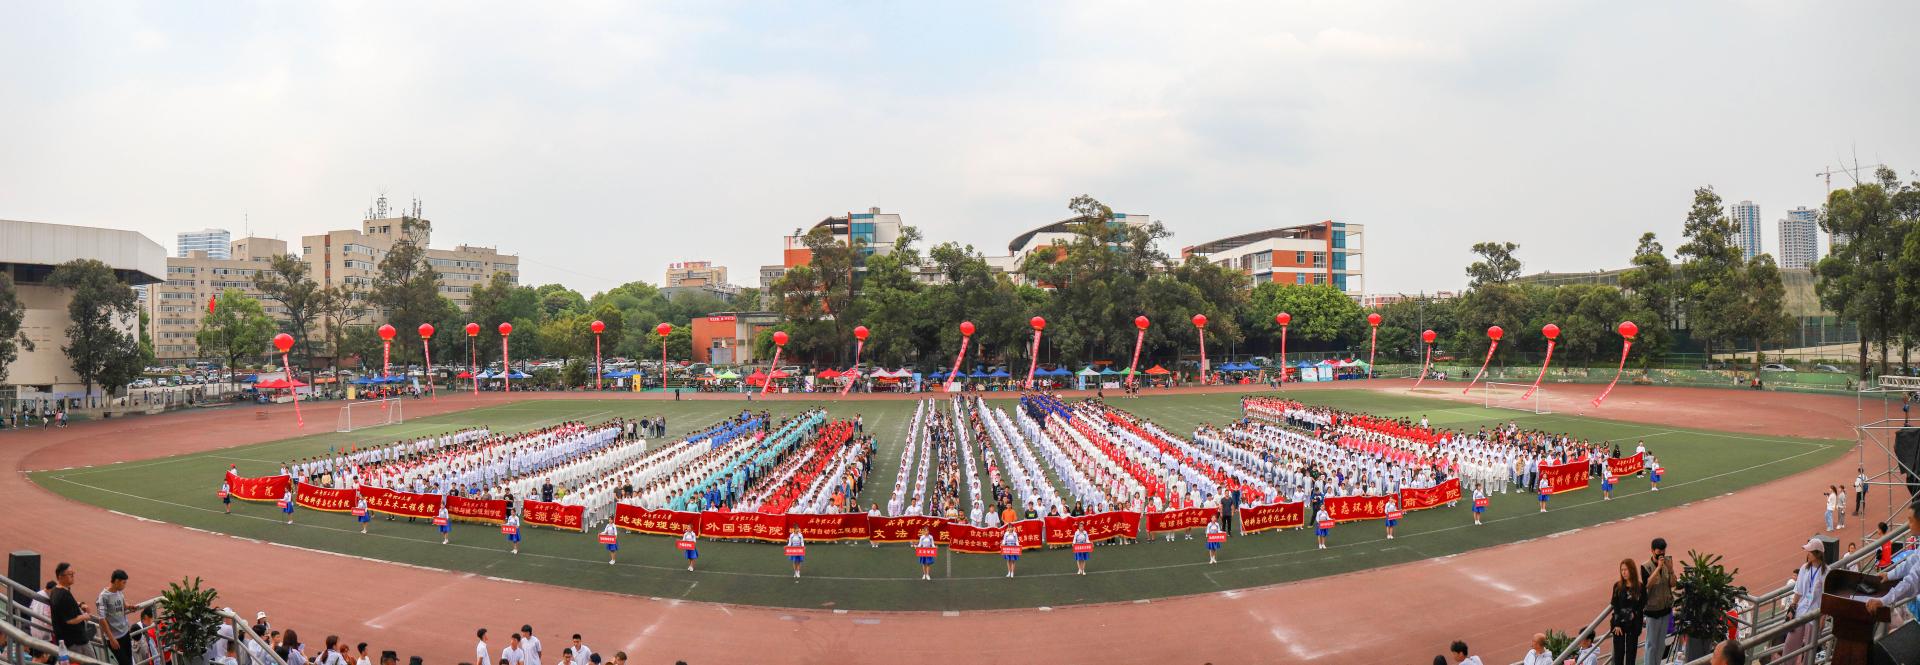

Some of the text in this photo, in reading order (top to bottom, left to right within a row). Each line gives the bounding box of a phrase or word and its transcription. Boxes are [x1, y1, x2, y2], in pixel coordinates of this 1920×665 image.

[1404, 488, 1459, 507] 商学院
[523, 508, 577, 525] 能源学院
[1329, 500, 1385, 516] 生态环境学
[705, 522, 784, 536] 外国语学院
[1053, 522, 1131, 539] 马克主义学院
